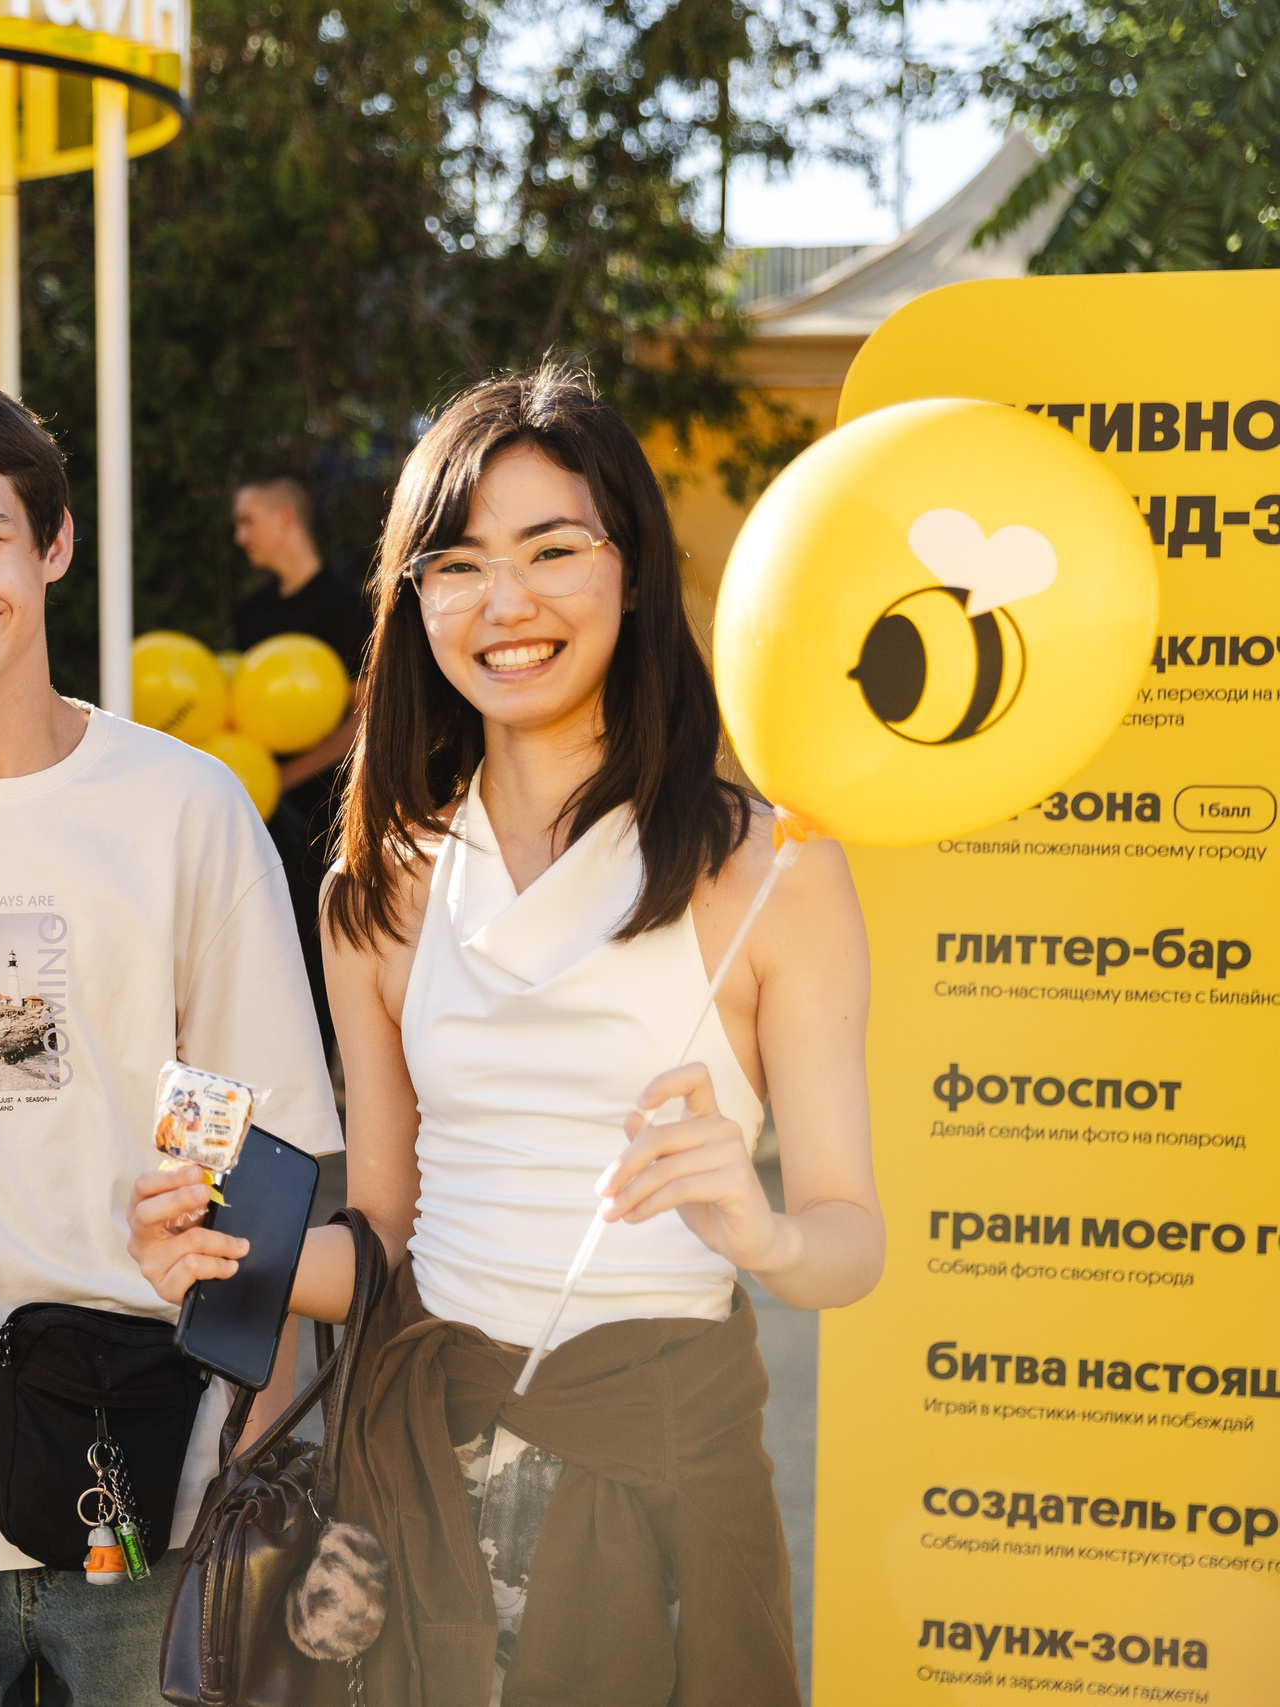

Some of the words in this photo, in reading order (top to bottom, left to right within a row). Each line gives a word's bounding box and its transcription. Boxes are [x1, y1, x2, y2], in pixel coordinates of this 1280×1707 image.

[1008, 399, 1280, 453] ТИВНО
[1133, 494, 1280, 559] НД-З
[1157, 689, 1248, 703] переходи
[1253, 690, 1272, 700] на
[1123, 714, 1184, 729] сперта
[1011, 791, 1161, 823] -зона
[938, 840, 1020, 854] Оставляй
[1024, 843, 1120, 856] пожелания
[1124, 845, 1195, 860] своему
[1199, 846, 1267, 862] городу
[28, 895, 54, 906] ARE
[937, 928, 1252, 980] глиттер-бар
[38, 913, 73, 1087] COMING
[934, 981, 977, 996] Сияй
[981, 986, 1121, 1004] по-настоящему
[1125, 990, 1191, 1003] вместе
[1195, 991, 1205, 1004] с
[933, 1063, 1182, 1112] фотоспот
[930, 1121, 985, 1137] Делай
[989, 1124, 1045, 1142] селфи
[1049, 1129, 1078, 1140] или
[1082, 1127, 1129, 1144] фото
[1133, 1133, 1152, 1144] на
[1156, 1133, 1246, 1150] полароид
[930, 1211, 1070, 1250] грани
[1081, 1218, 1246, 1254] моего
[1257, 1225, 1280, 1255] г
[927, 1258, 1007, 1278] Собирай
[1010, 1262, 1057, 1280] фото
[1060, 1268, 1125, 1282] своего
[1128, 1271, 1194, 1287] города
[926, 1341, 1066, 1387] битва
[924, 1398, 977, 1416] Играй
[981, 1405, 989, 1415] в
[993, 1405, 1144, 1425] крестики-нолики
[1148, 1414, 1157, 1425] и
[1161, 1412, 1254, 1433] побеждай
[923, 1487, 1176, 1531] создатель
[1187, 1503, 1280, 1546] гор
[921, 1533, 1000, 1554] Собирай
[1003, 1541, 1041, 1556] пазл
[1045, 1546, 1074, 1557] или
[1078, 1547, 1195, 1569] конструктор
[1198, 1555, 1265, 1572] своего
[918, 1619, 1208, 1670] лаунж-зона
[917, 1665, 993, 1685] Отдыхай
[997, 1676, 1006, 1685] и
[1010, 1676, 1083, 1693] заряжай
[1087, 1682, 1130, 1697] свои
[1133, 1686, 1209, 1704] гаджеты
